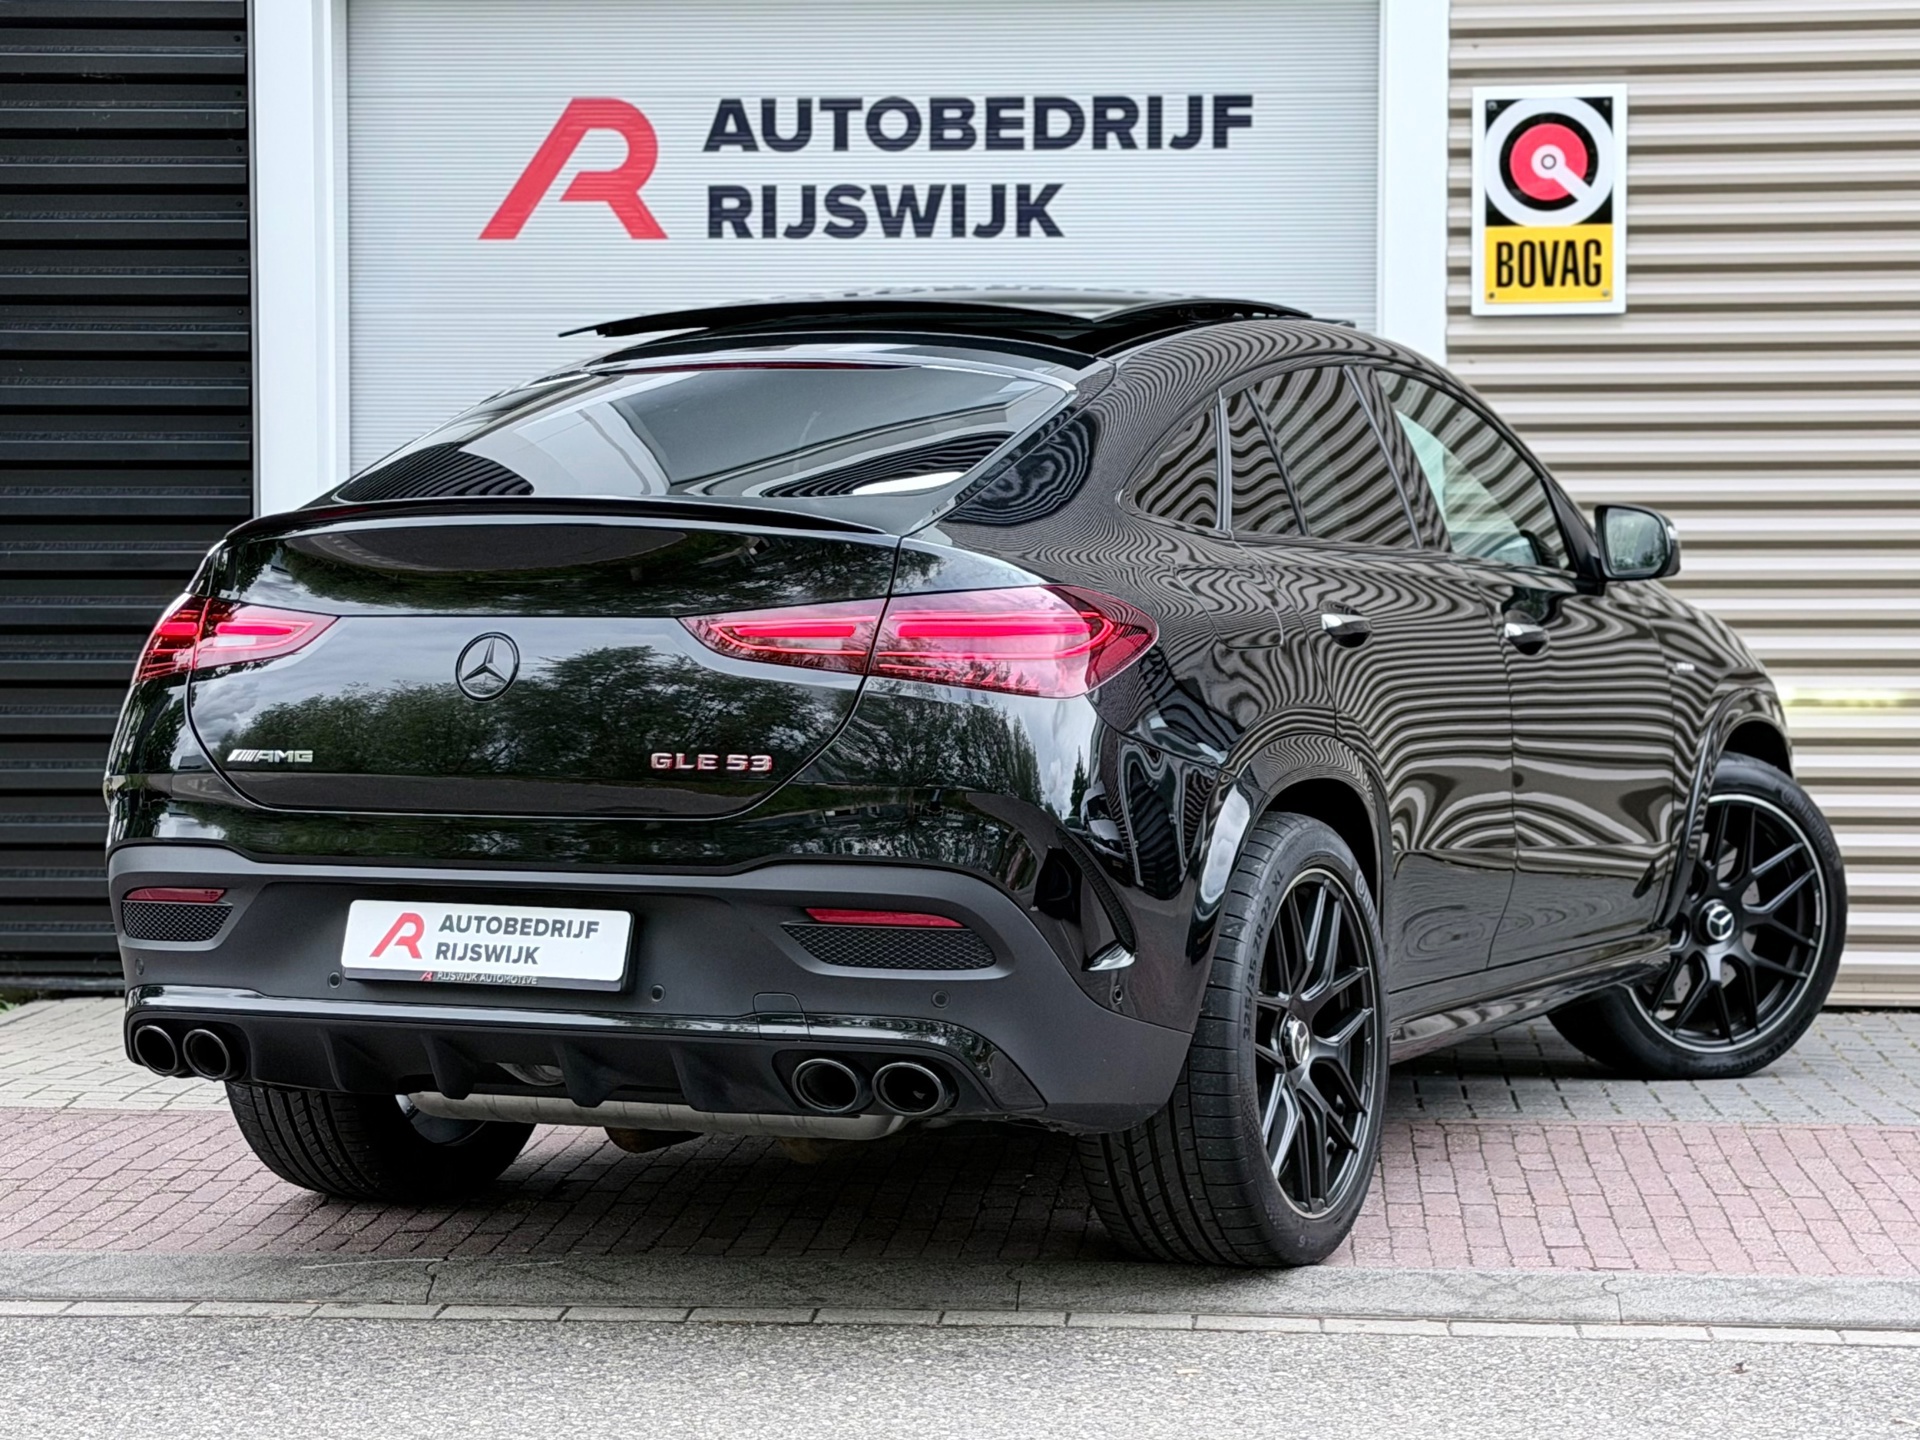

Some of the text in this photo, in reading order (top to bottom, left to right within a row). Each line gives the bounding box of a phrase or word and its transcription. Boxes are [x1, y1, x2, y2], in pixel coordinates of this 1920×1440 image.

[703, 95, 1254, 151] AUTOBEDRIJF
[707, 183, 1065, 238] RIJSWIJK
[1496, 239, 1603, 288] BOVAG
[651, 752, 773, 771] GLE 53
[1261, 896, 1272, 922] 22
[438, 914, 600, 939] AUTOBEDRIJF
[435, 942, 540, 965] RIJSWIJK
[437, 971, 538, 985] RIJSWIJK AUTOMOTIVE
